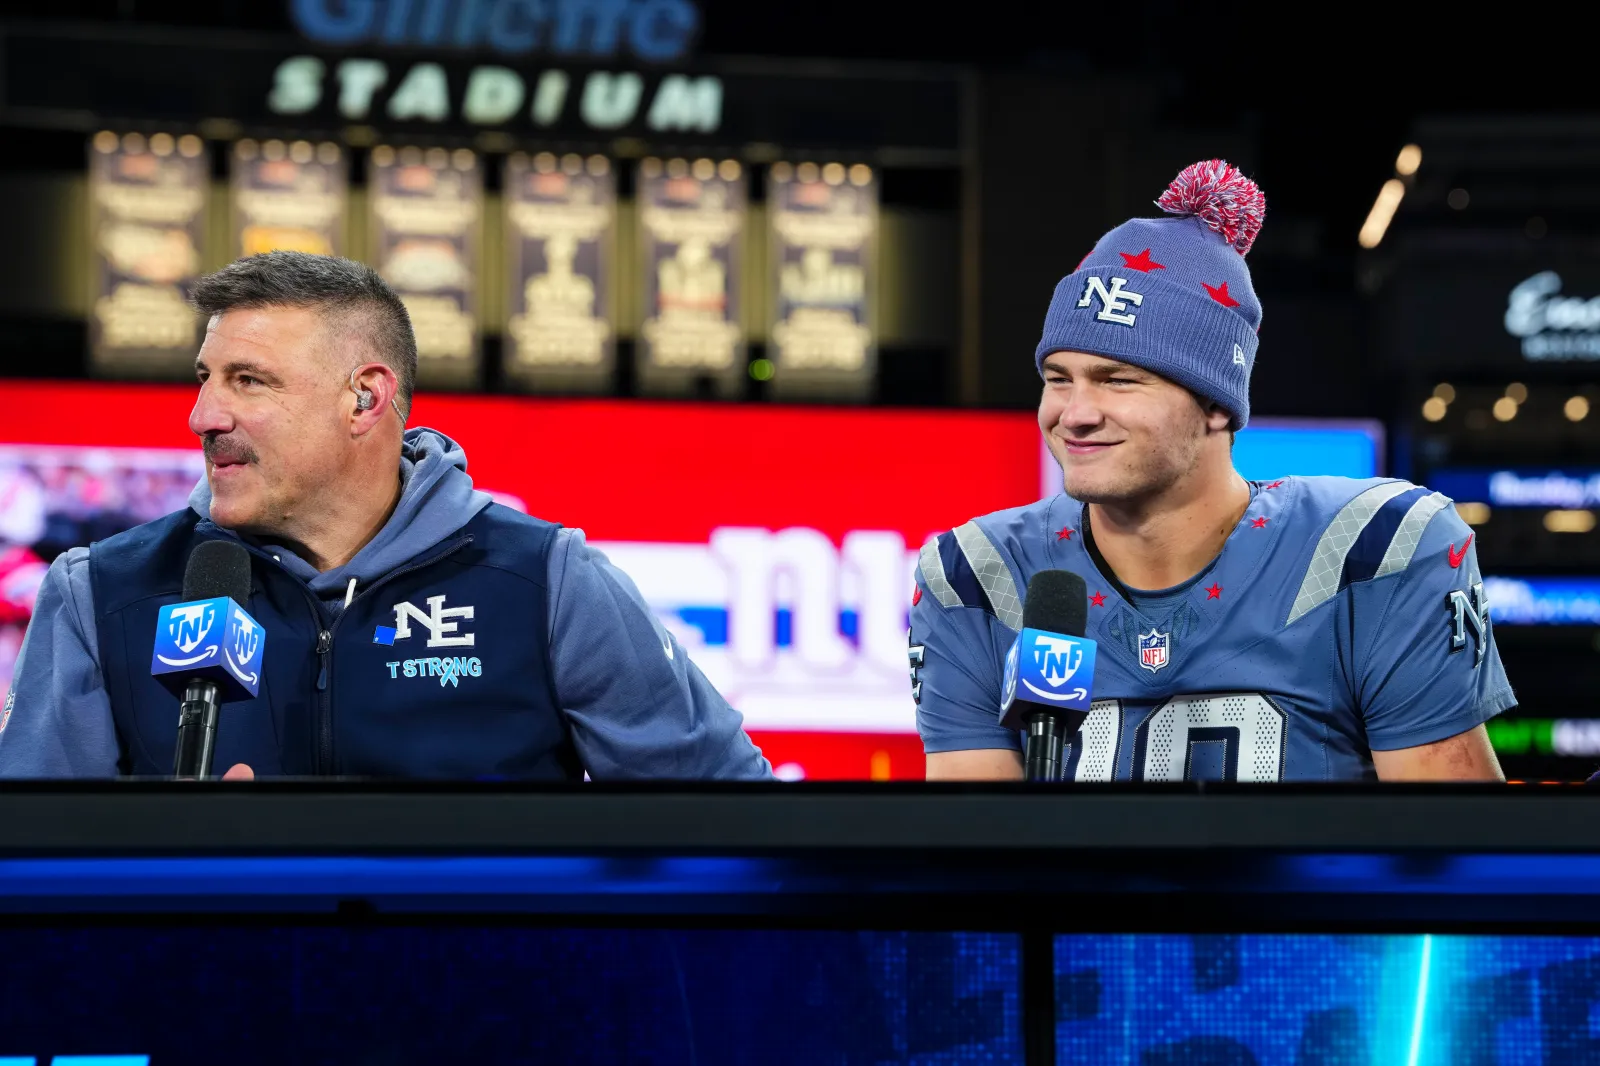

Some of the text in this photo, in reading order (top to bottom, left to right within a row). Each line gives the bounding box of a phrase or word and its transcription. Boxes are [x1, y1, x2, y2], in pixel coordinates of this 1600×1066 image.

[269, 56, 723, 132] STADIUM
[1077, 276, 1144, 327] NE
[169, 603, 215, 653] TNF
[232, 609, 259, 666] TNF
[393, 594, 475, 648] NE
[386, 661, 400, 679] T
[1034, 635, 1083, 688] TNF
[1143, 648, 1165, 665] NFL
